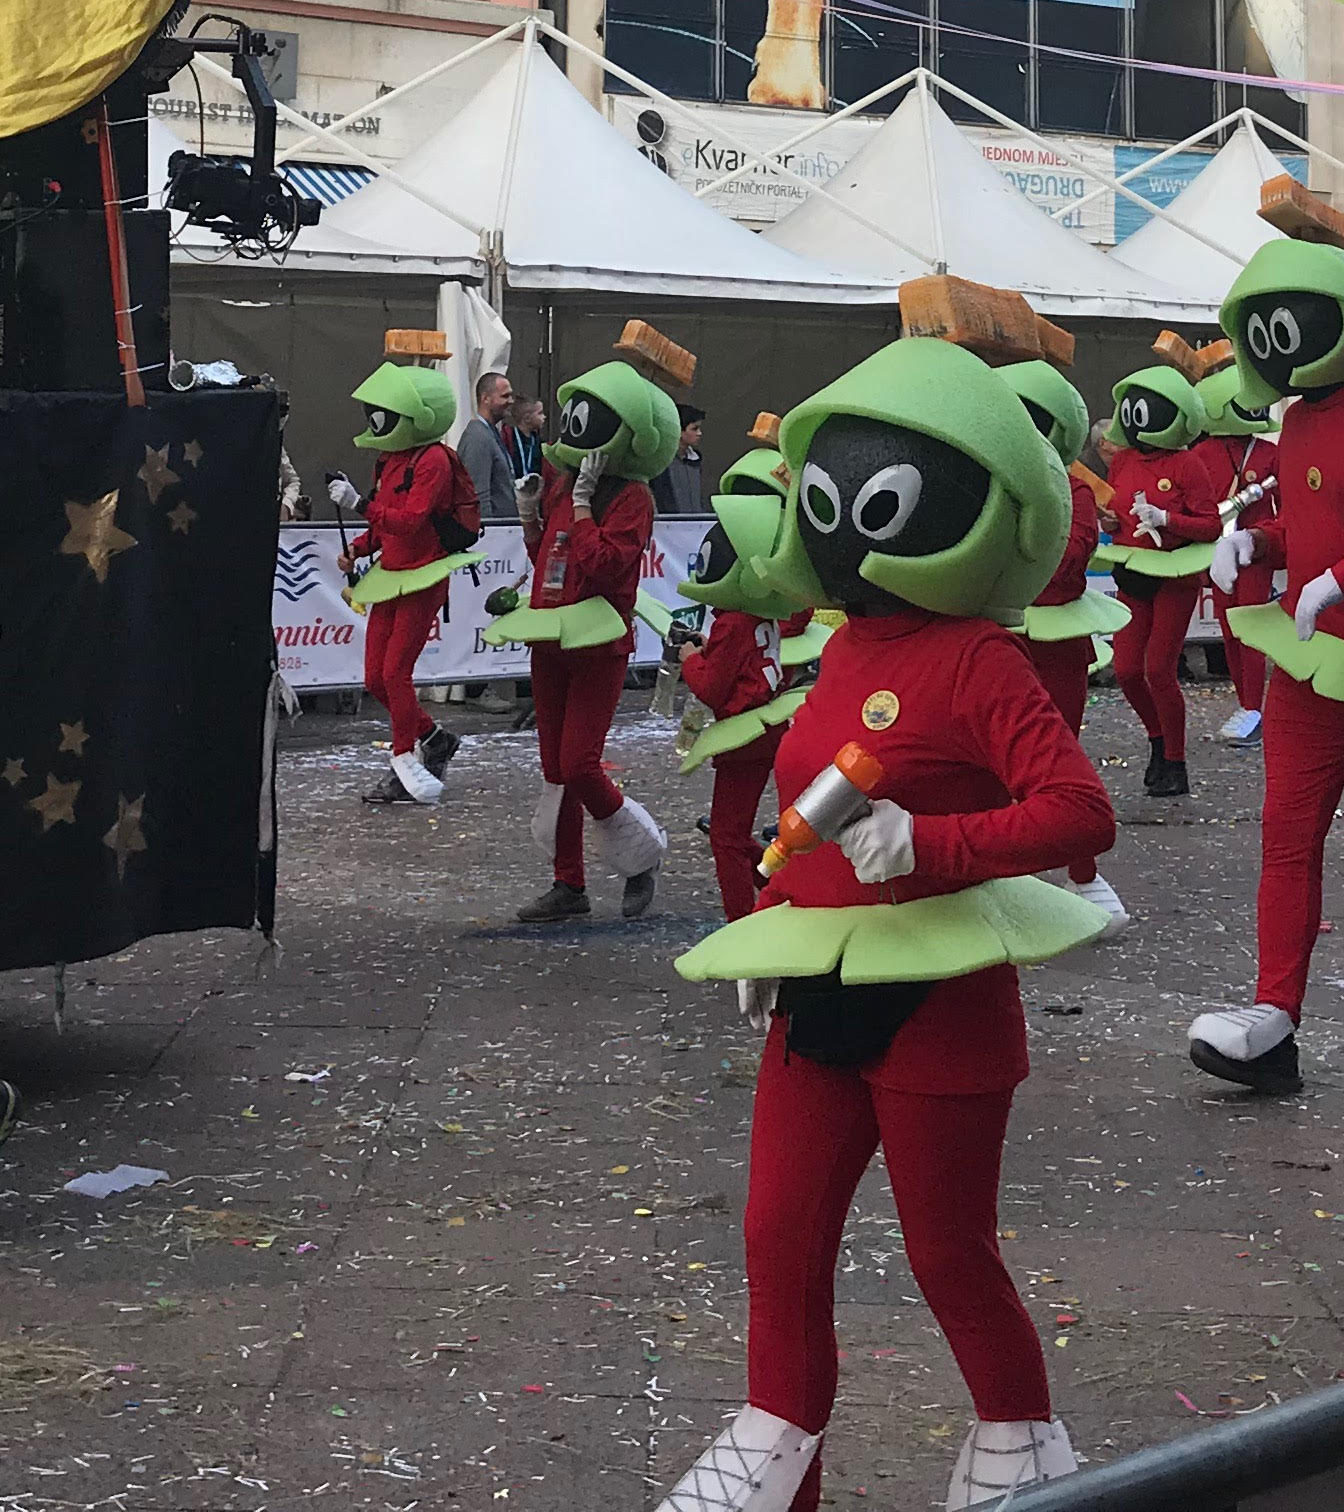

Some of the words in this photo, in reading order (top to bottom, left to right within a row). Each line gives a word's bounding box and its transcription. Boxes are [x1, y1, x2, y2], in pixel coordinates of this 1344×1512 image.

[239, 104, 382, 135] INMATION
[696, 178, 766, 196] POUZETNIČKI
[274, 618, 355, 648] mnica
